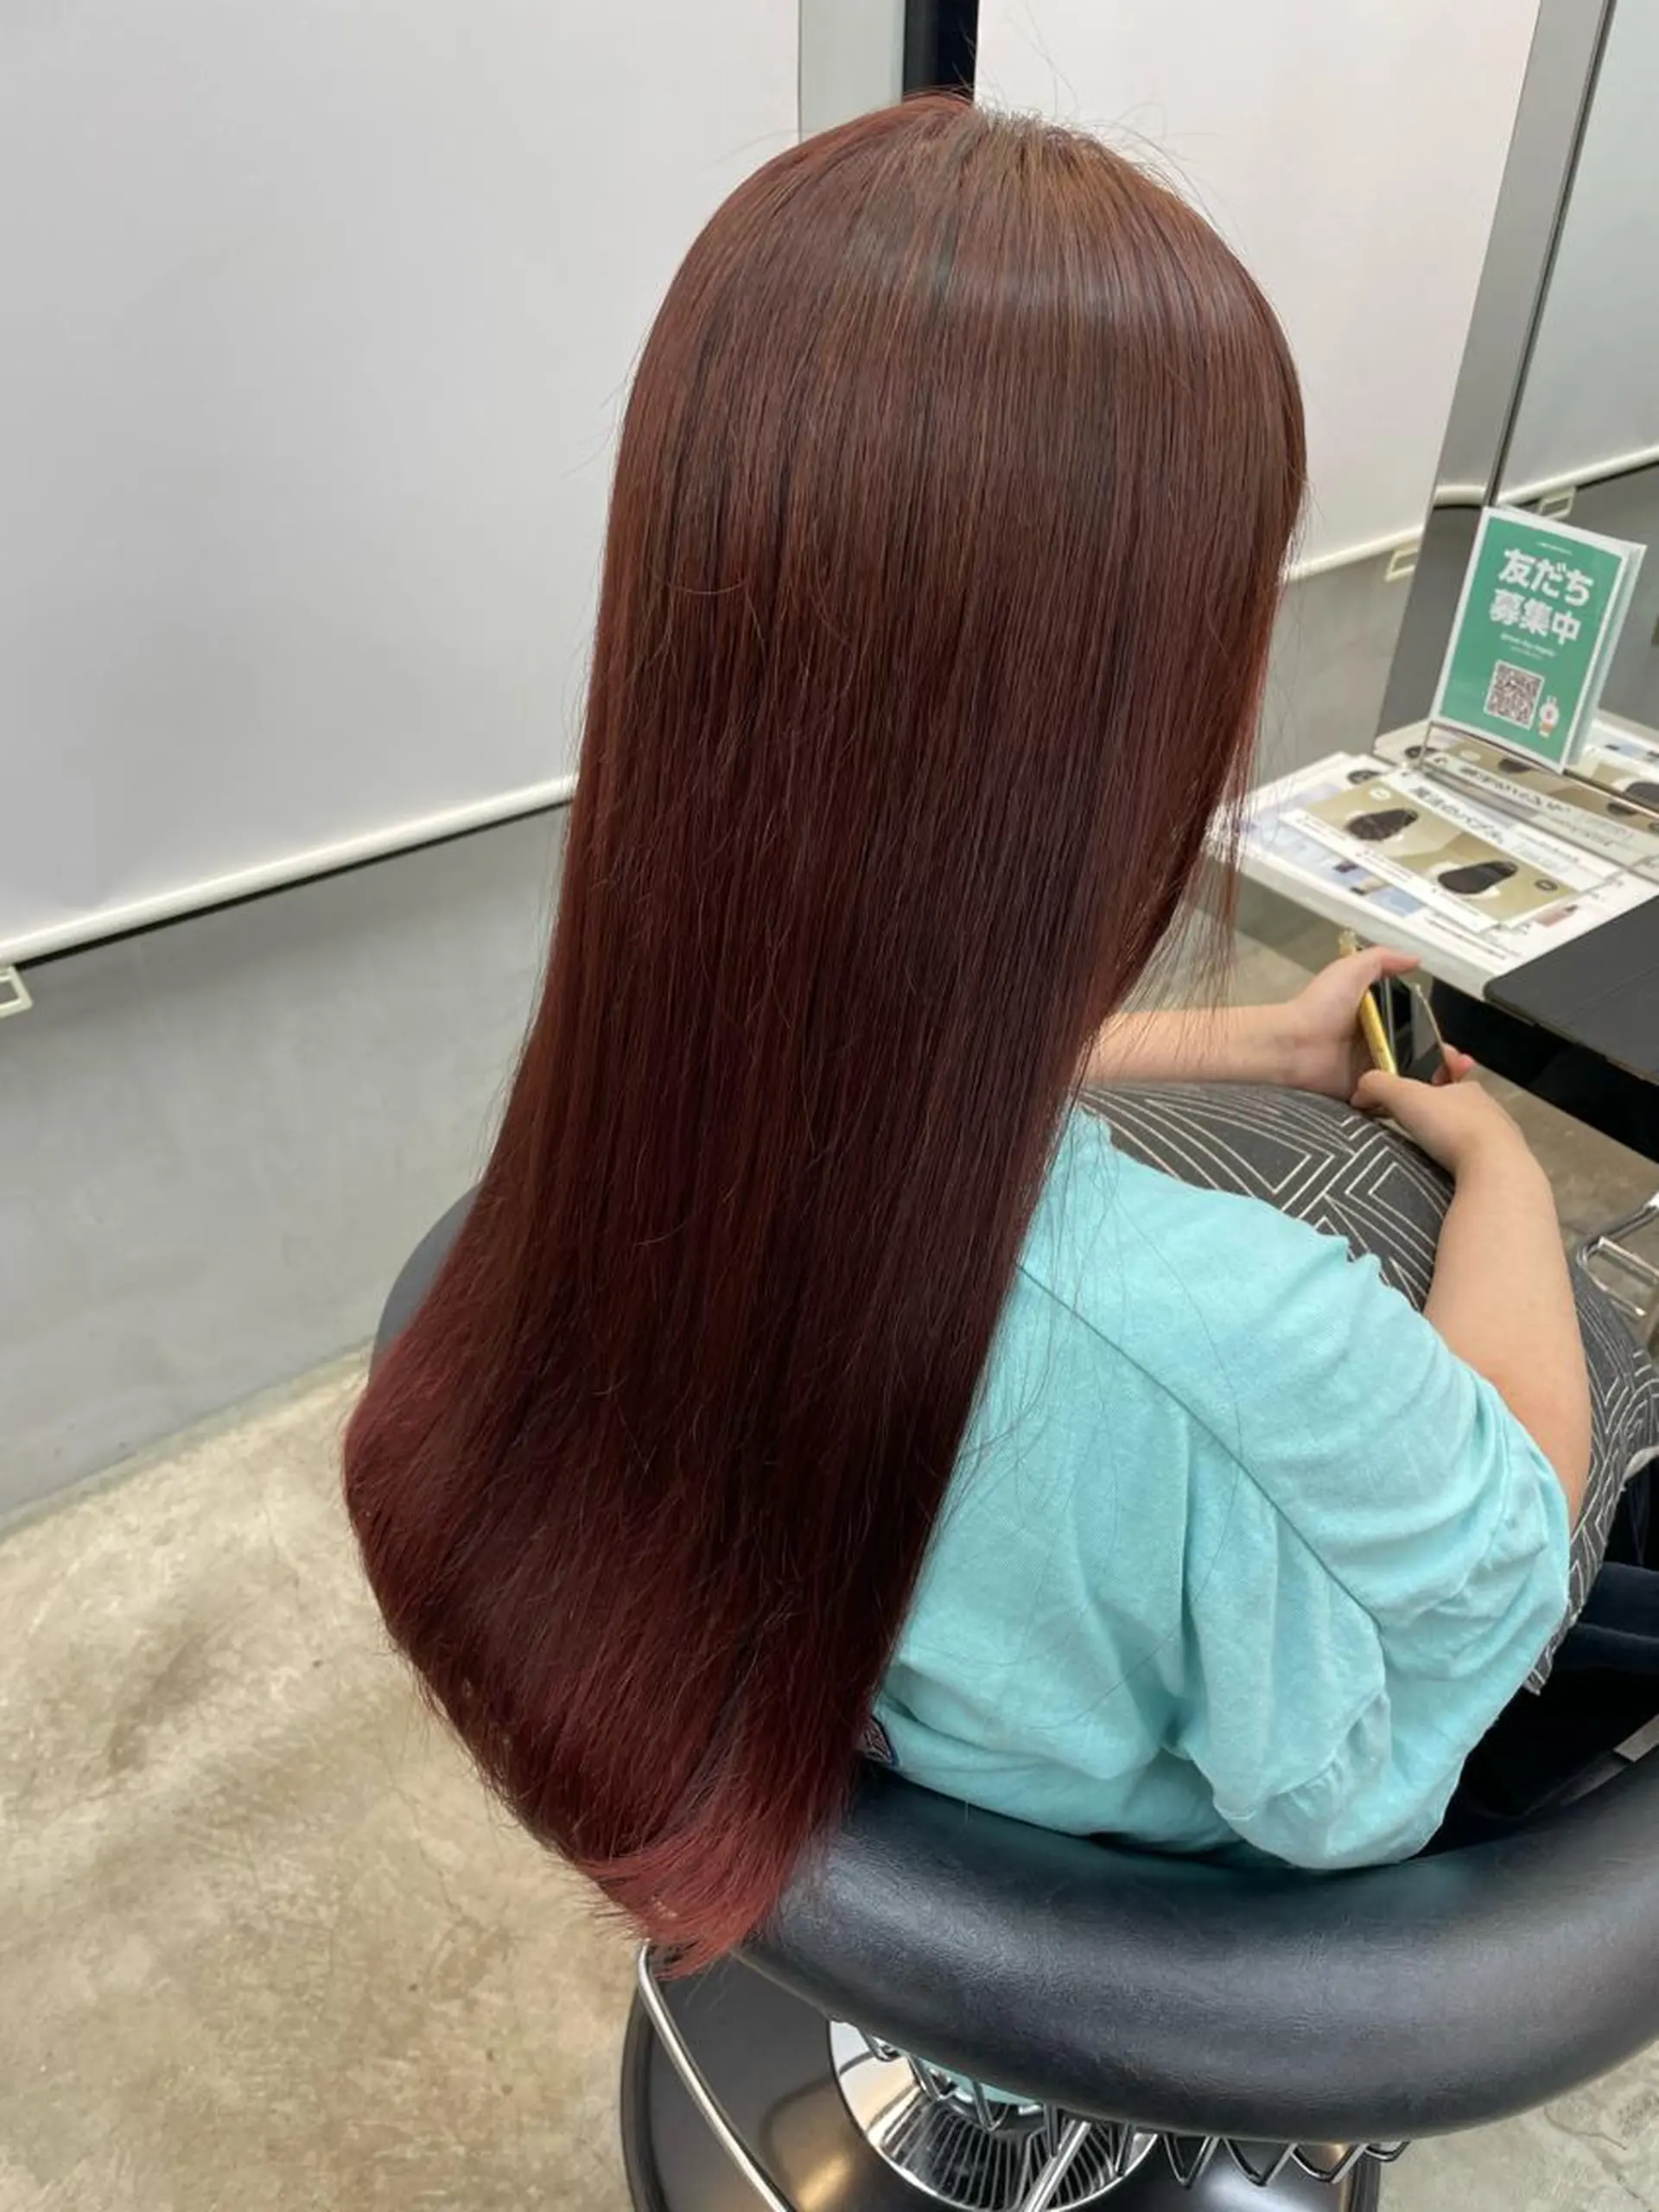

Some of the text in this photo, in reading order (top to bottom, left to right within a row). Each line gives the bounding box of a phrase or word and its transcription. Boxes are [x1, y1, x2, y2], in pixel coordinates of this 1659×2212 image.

[1497, 548, 1594, 607] 友だち
[1489, 588, 1581, 645] 募集中
